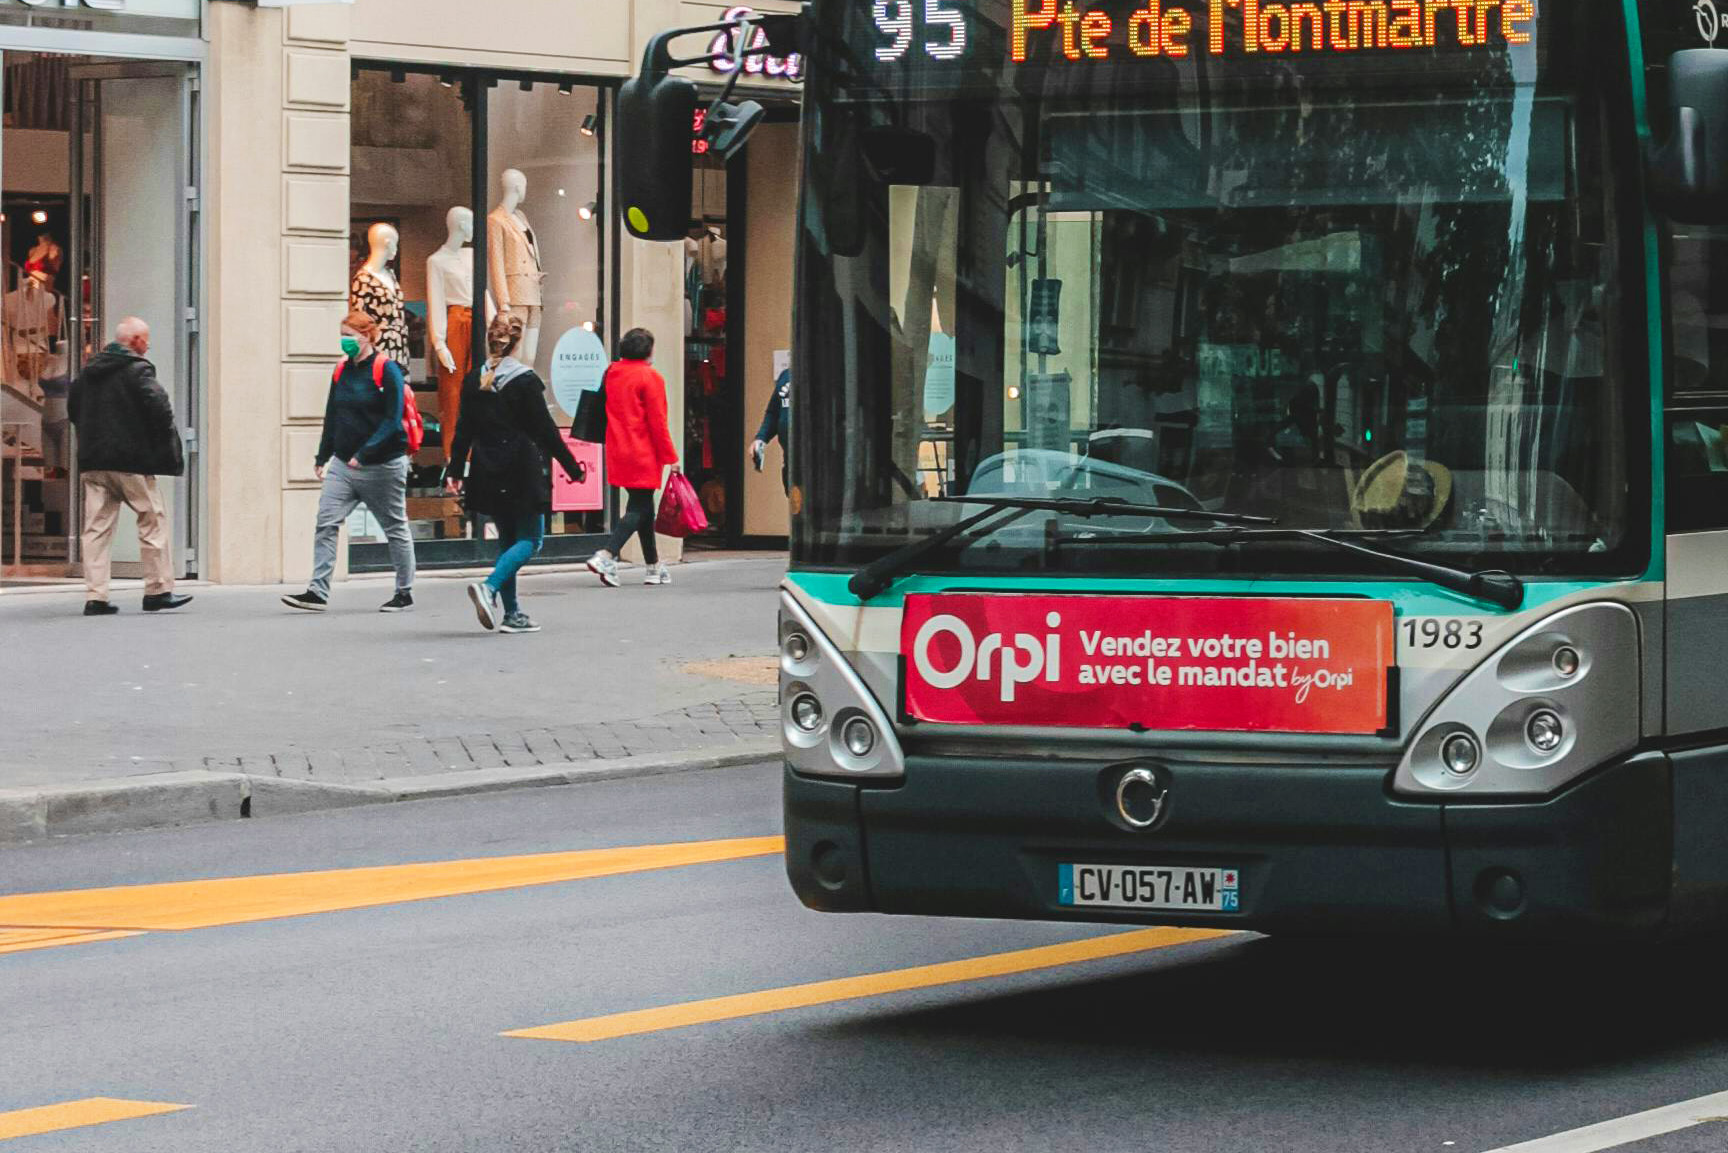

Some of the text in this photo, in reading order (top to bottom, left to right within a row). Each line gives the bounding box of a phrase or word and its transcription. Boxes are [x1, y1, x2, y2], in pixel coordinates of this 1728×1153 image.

[1079, 630, 1329, 659] Vendez votre bien
[1403, 618, 1484, 650] 1983
[913, 611, 1062, 702] Orpi
[1078, 664, 1141, 685] avec
[1147, 658, 1172, 686] le
[1178, 660, 1288, 688] mandat
[1079, 867, 1216, 904] CV-057-AW
[1223, 891, 1239, 908] 75
